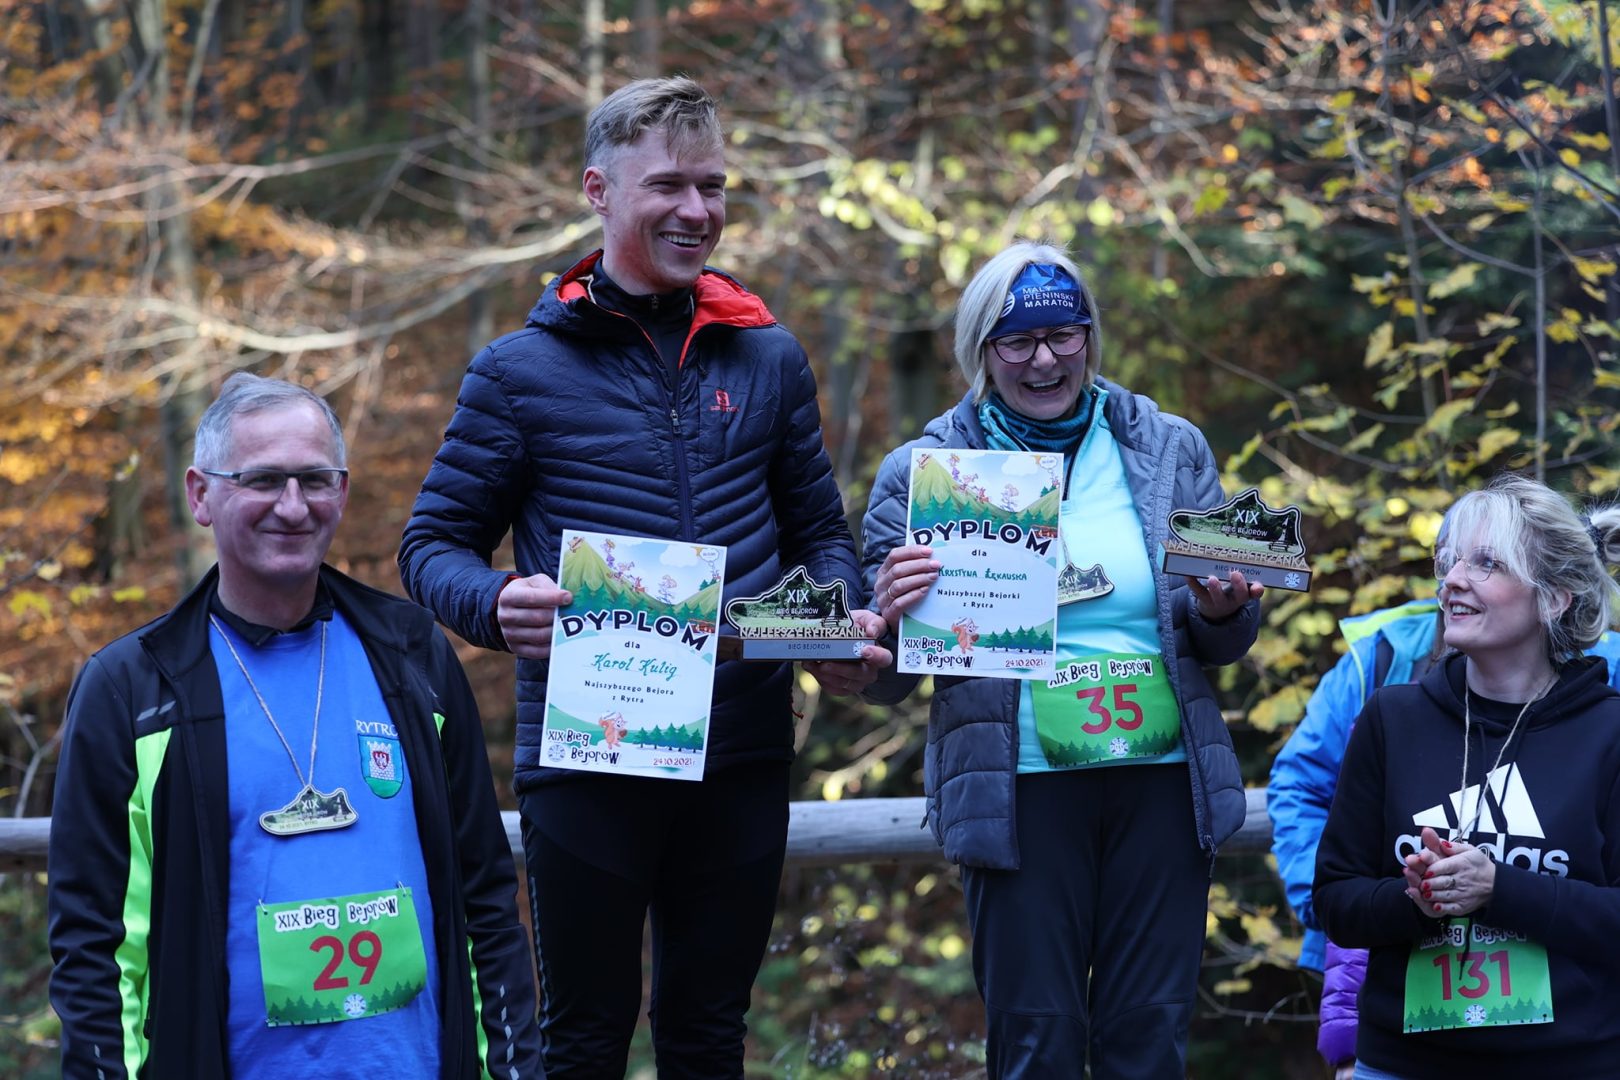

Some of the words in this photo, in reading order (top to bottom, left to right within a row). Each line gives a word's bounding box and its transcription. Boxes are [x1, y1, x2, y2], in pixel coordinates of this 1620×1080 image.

[1235, 509, 1260, 524] XIX
[913, 520, 1052, 556] DYPLOM
[971, 549, 987, 557] dla
[787, 590, 809, 603] XIX
[937, 589, 985, 598] Najszybszej
[561, 611, 709, 651] DYPLOM
[624, 641, 641, 649] dla
[904, 638, 919, 648] XIX
[921, 637, 943, 653] Bieg
[591, 653, 635, 671] Karol
[639, 658, 677, 681] Kulig
[1070, 663, 1099, 680] Bieg
[584, 680, 642, 693] Najszybszego
[646, 686, 674, 695] Bejora
[620, 695, 644, 703] Rytra
[1076, 684, 1143, 734] 35
[548, 730, 564, 741] XIX
[566, 729, 590, 746] Bieg
[301, 799, 320, 810] XIX
[1395, 829, 1570, 878] adas
[278, 913, 301, 928] XIX
[304, 907, 336, 925] Bieg
[309, 930, 382, 991] 29
[1433, 950, 1511, 1000] 131
